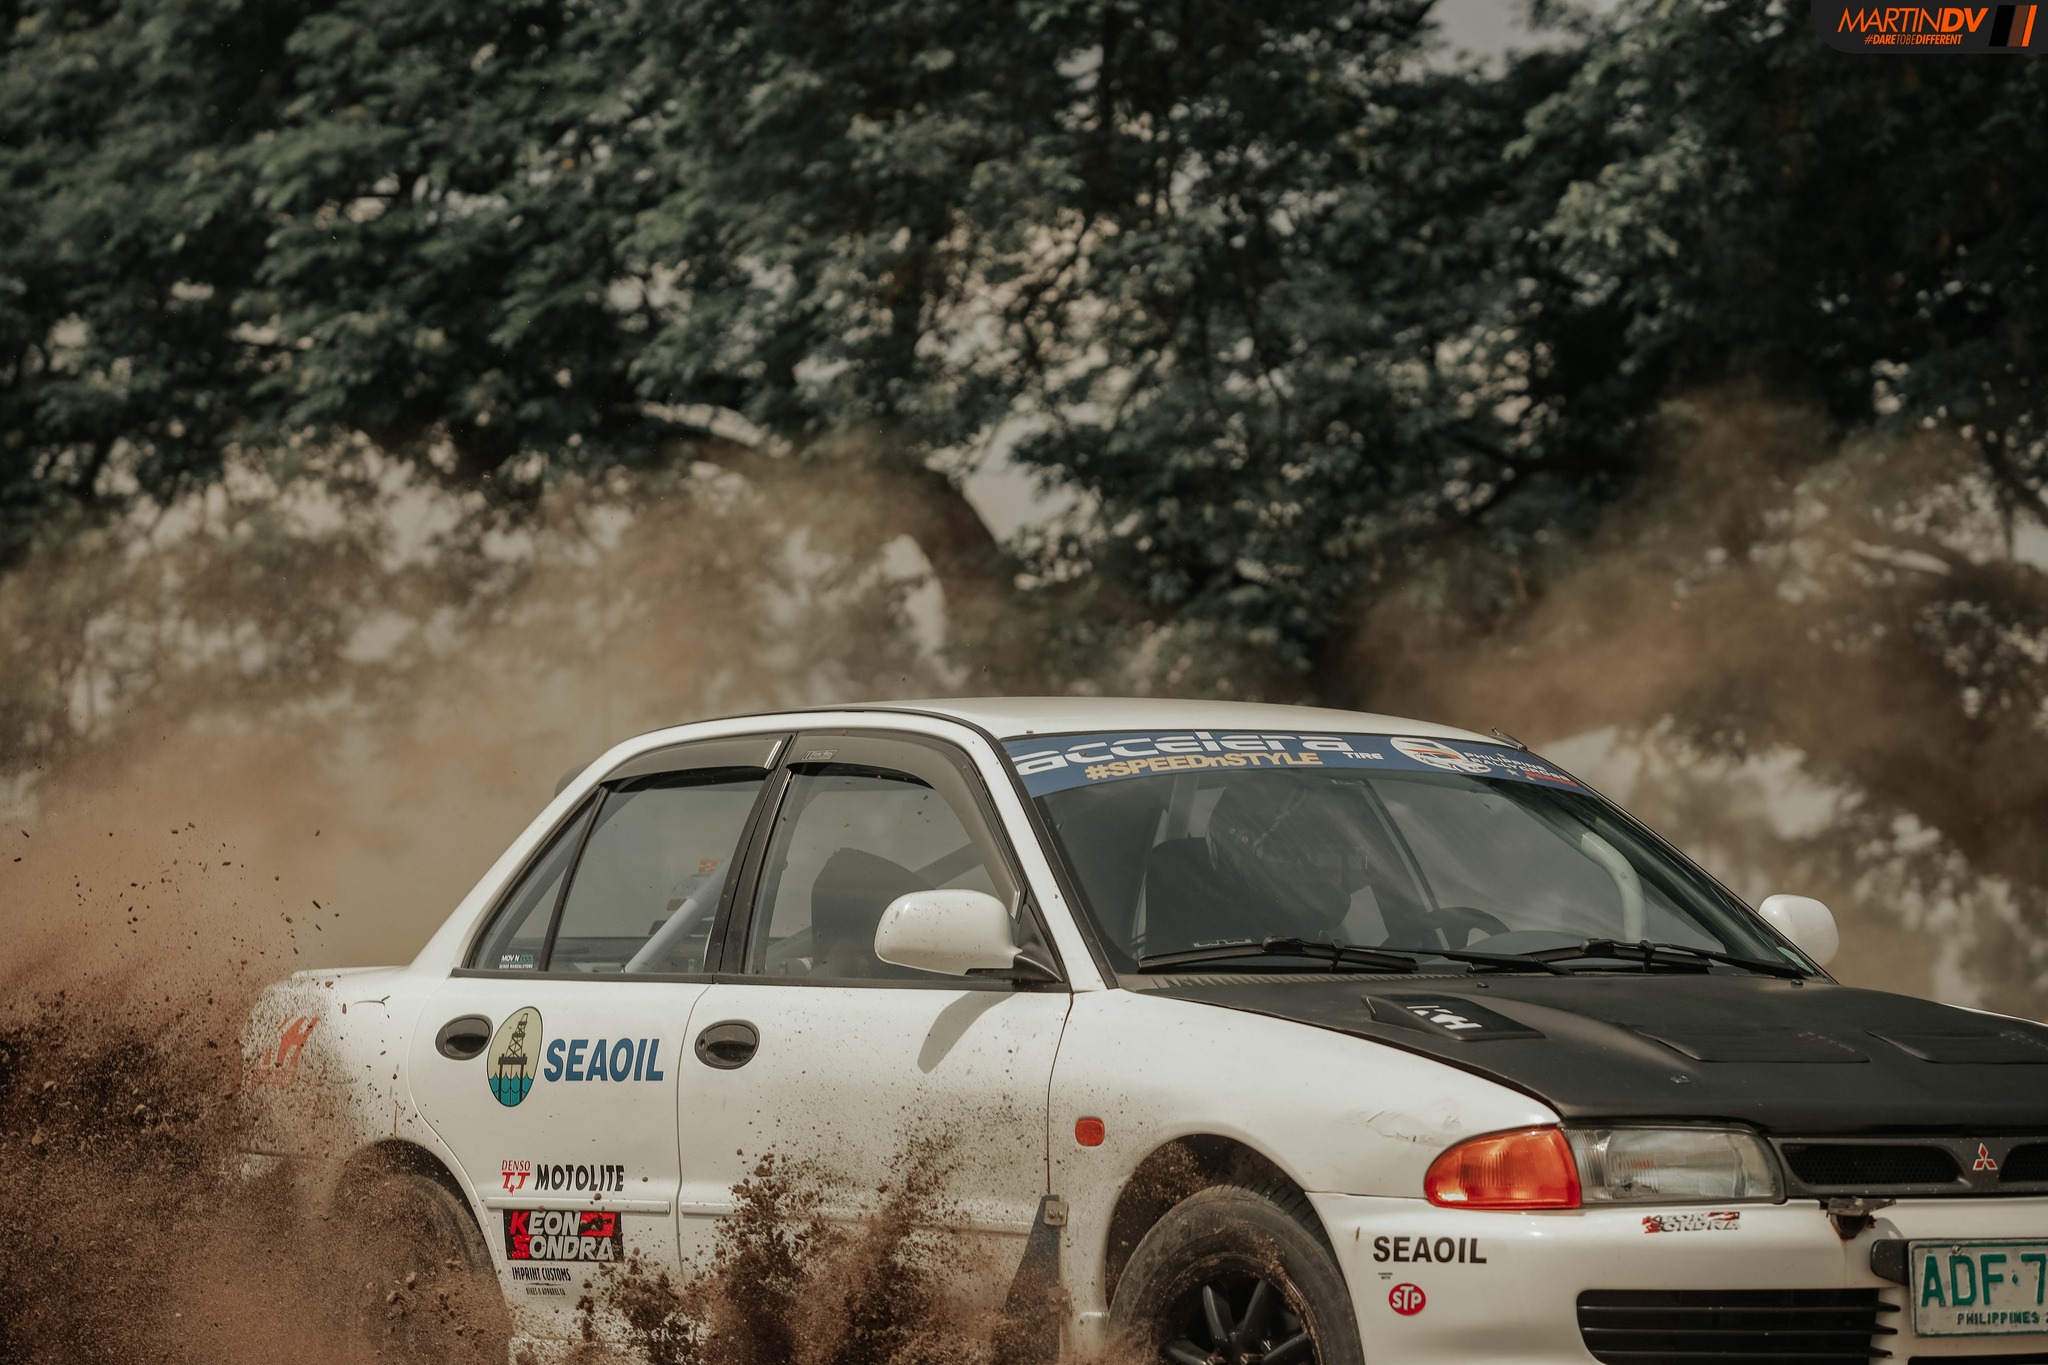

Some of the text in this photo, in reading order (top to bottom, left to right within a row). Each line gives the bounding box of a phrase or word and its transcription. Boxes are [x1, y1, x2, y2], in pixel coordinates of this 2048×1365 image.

[1011, 731, 1354, 776] accelera
[1084, 752, 1323, 780] #SPEEDnSTYLE
[1342, 752, 1384, 760] TIRE
[544, 1037, 664, 1082] SEAOIL
[501, 1160, 531, 1171] DENSO
[534, 1164, 625, 1192] MOTOLITE
[510, 1211, 582, 1236] KEON
[511, 1234, 615, 1261] SONDRA
[1373, 1236, 1487, 1264] SEAOIL
[511, 1267, 571, 1281] IMPRINT CUSTOMS
[1392, 1286, 1422, 1311] STP
[1957, 1311, 2040, 1325] PHILIPPINES
